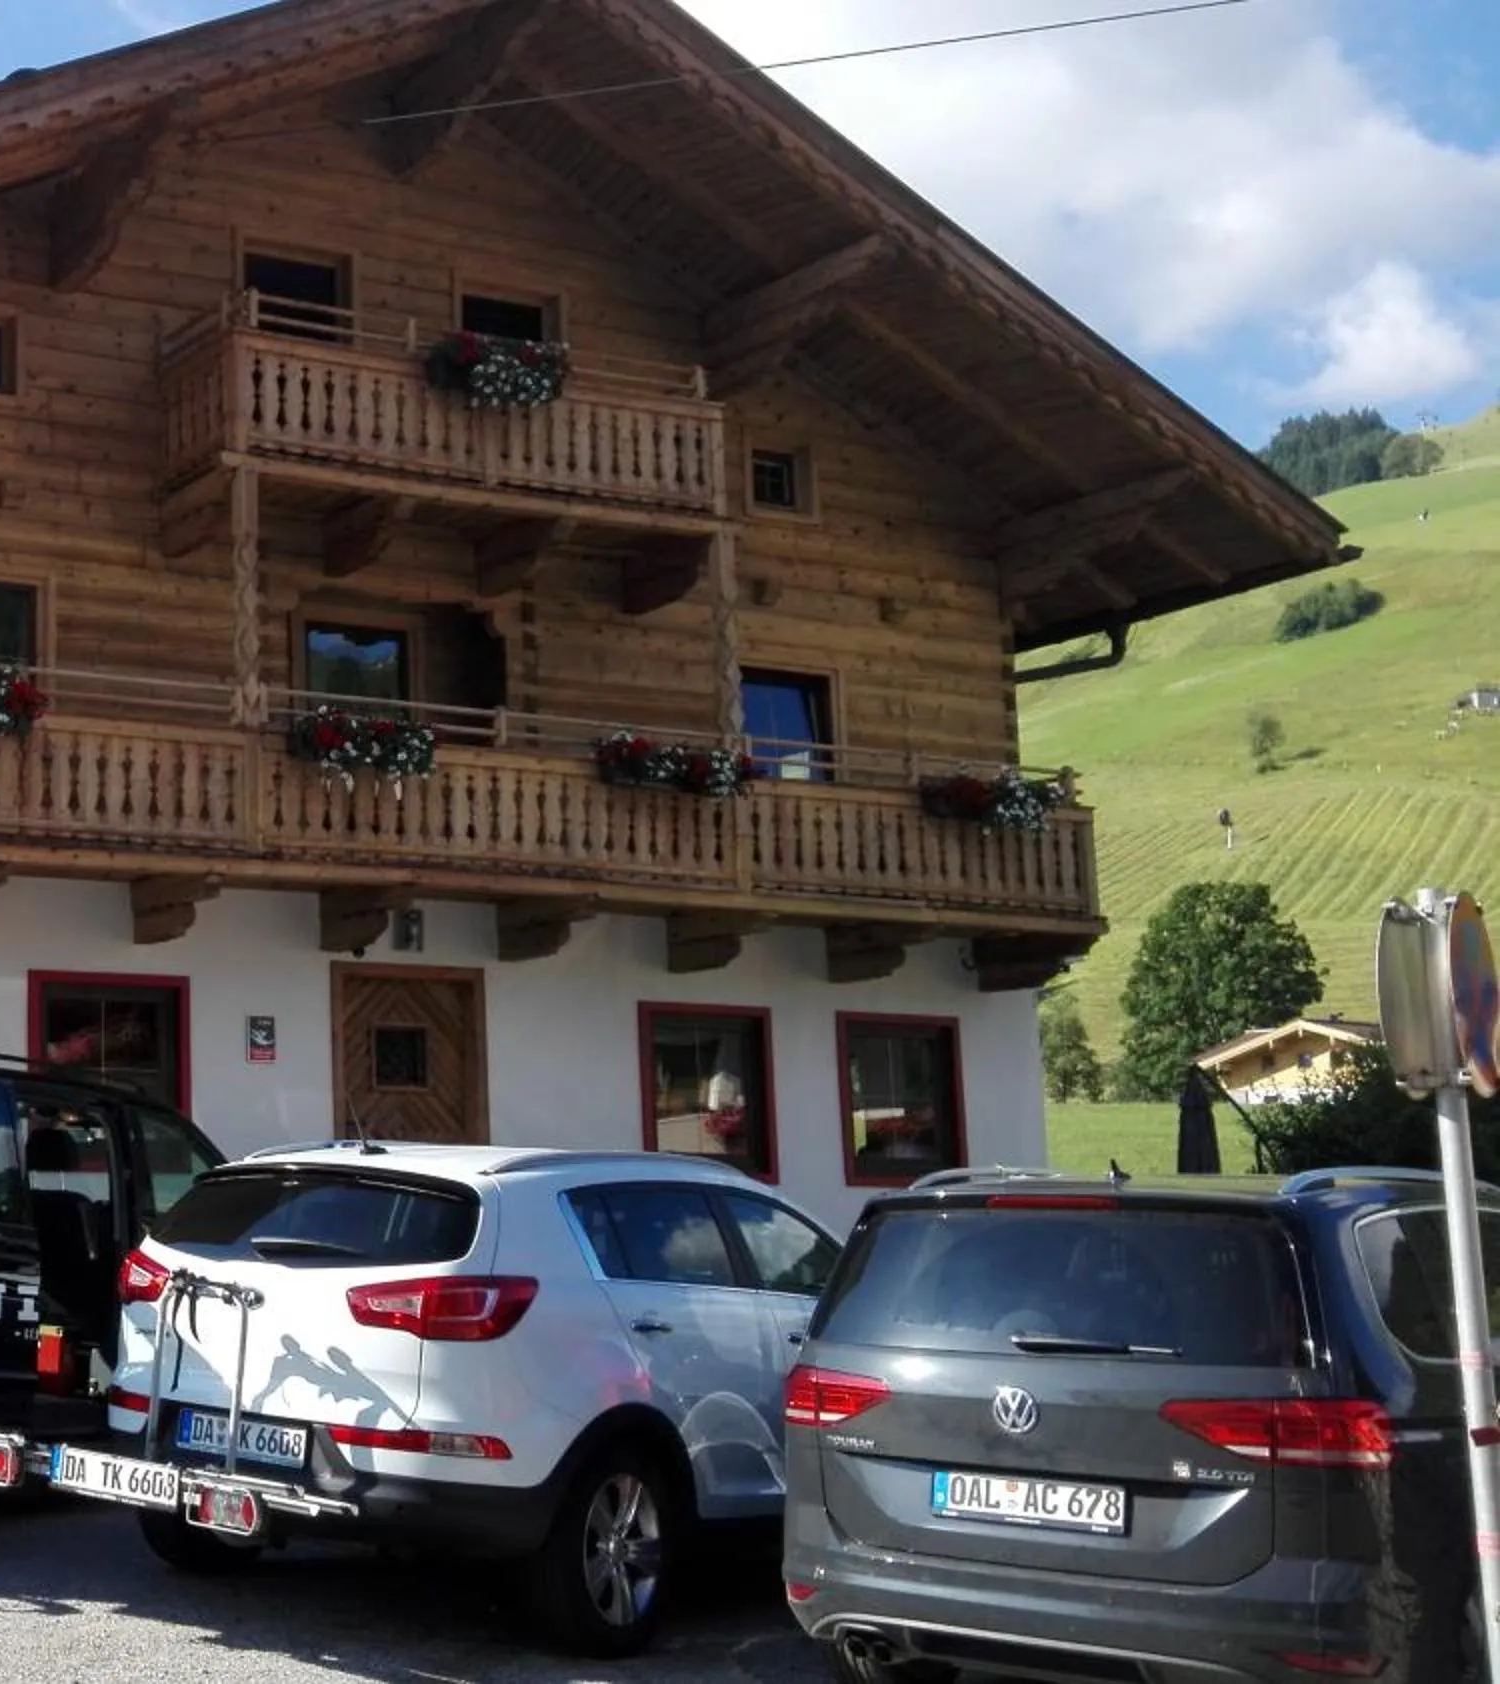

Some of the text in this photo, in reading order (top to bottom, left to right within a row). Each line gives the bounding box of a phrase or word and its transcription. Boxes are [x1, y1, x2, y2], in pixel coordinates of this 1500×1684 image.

[192, 1416, 214, 1444] DA
[255, 1427, 303, 1457] 6608
[65, 1455, 86, 1483] DA
[101, 1461, 123, 1490] TK
[128, 1467, 175, 1500] 6608
[950, 1475, 1122, 1522] OAL AC 678
